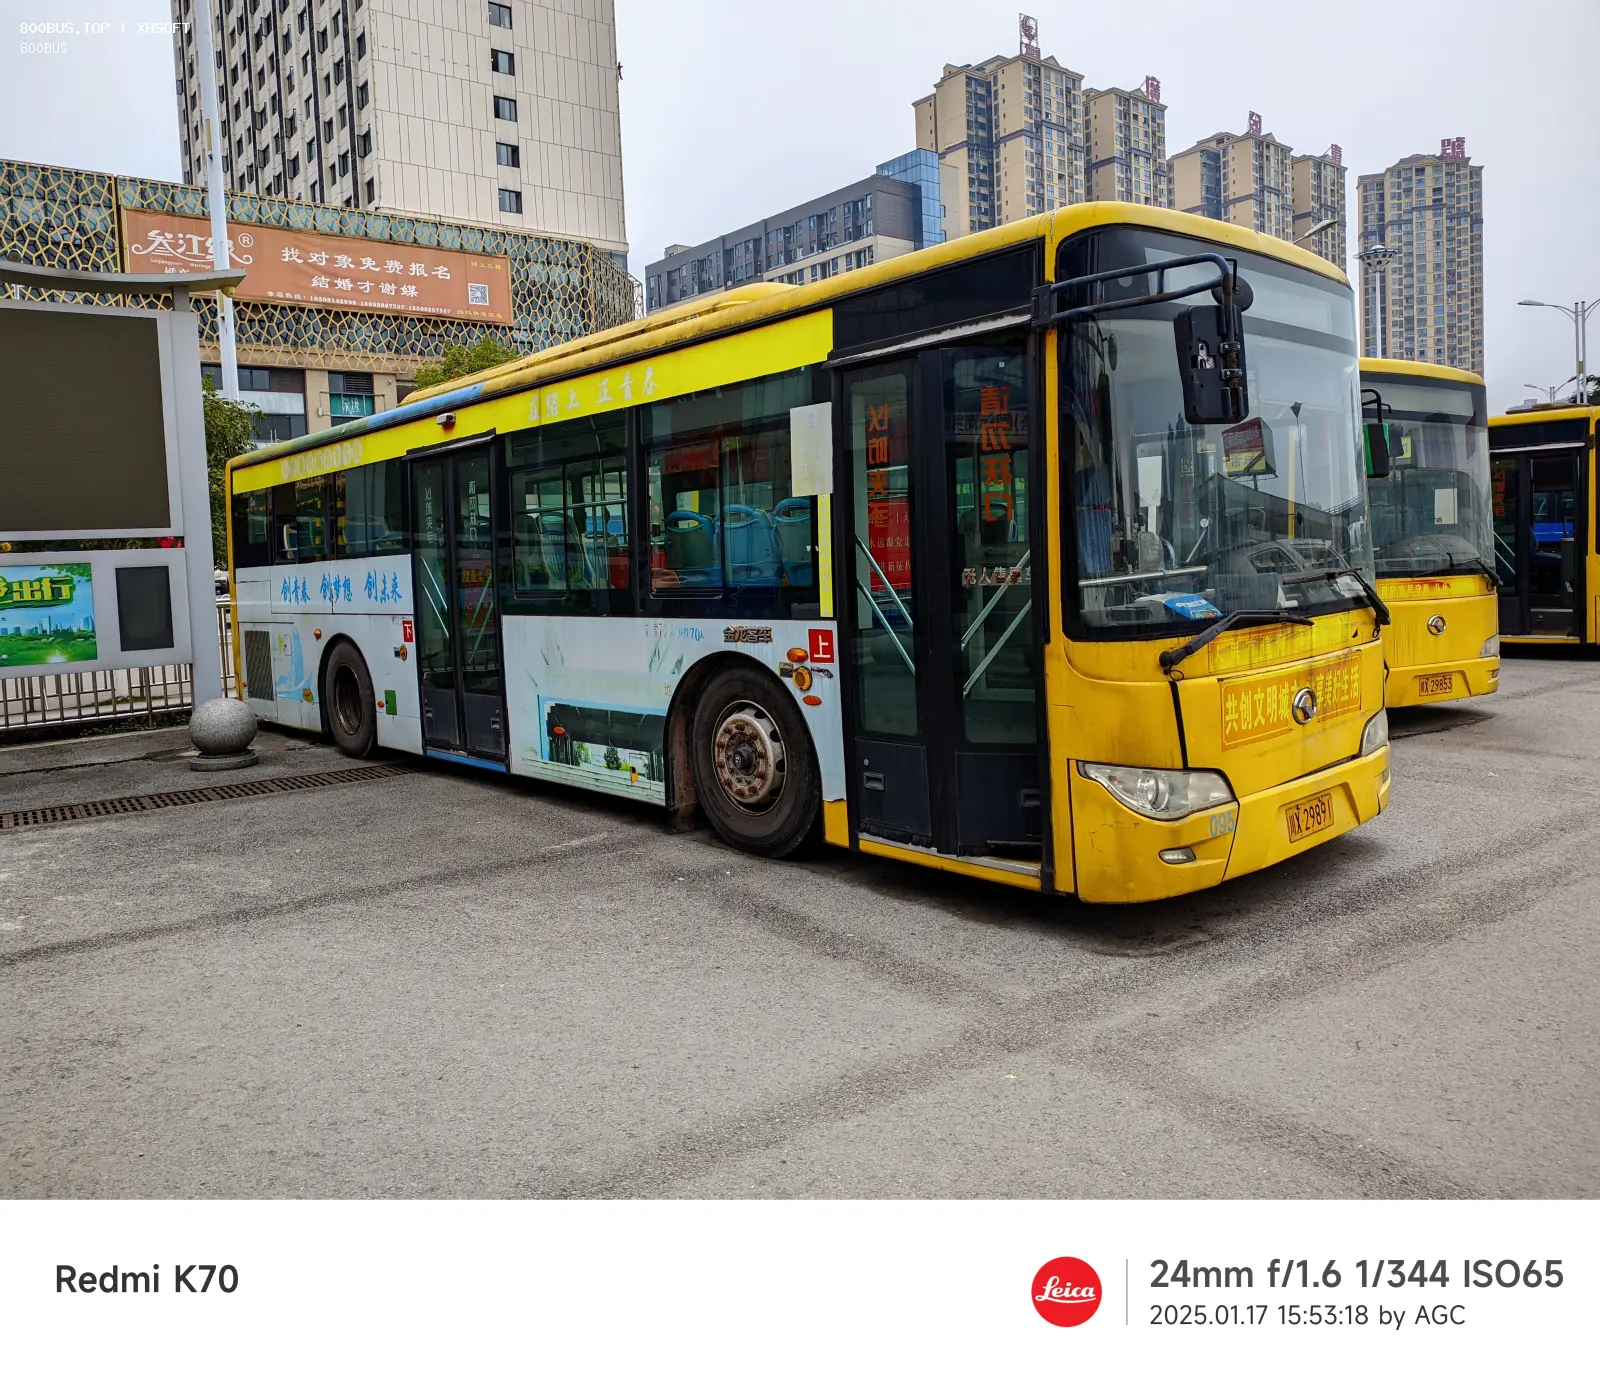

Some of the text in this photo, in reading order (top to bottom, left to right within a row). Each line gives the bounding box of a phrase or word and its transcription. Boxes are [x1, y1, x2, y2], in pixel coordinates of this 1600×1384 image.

[281, 246, 451, 280] 找对象免费报名
[311, 275, 419, 298] 结婚才谢媒
[722, 625, 773, 644] 金龙客车
[813, 634, 831, 659] 上
[1309, 664, 1361, 710] 享美好生活
